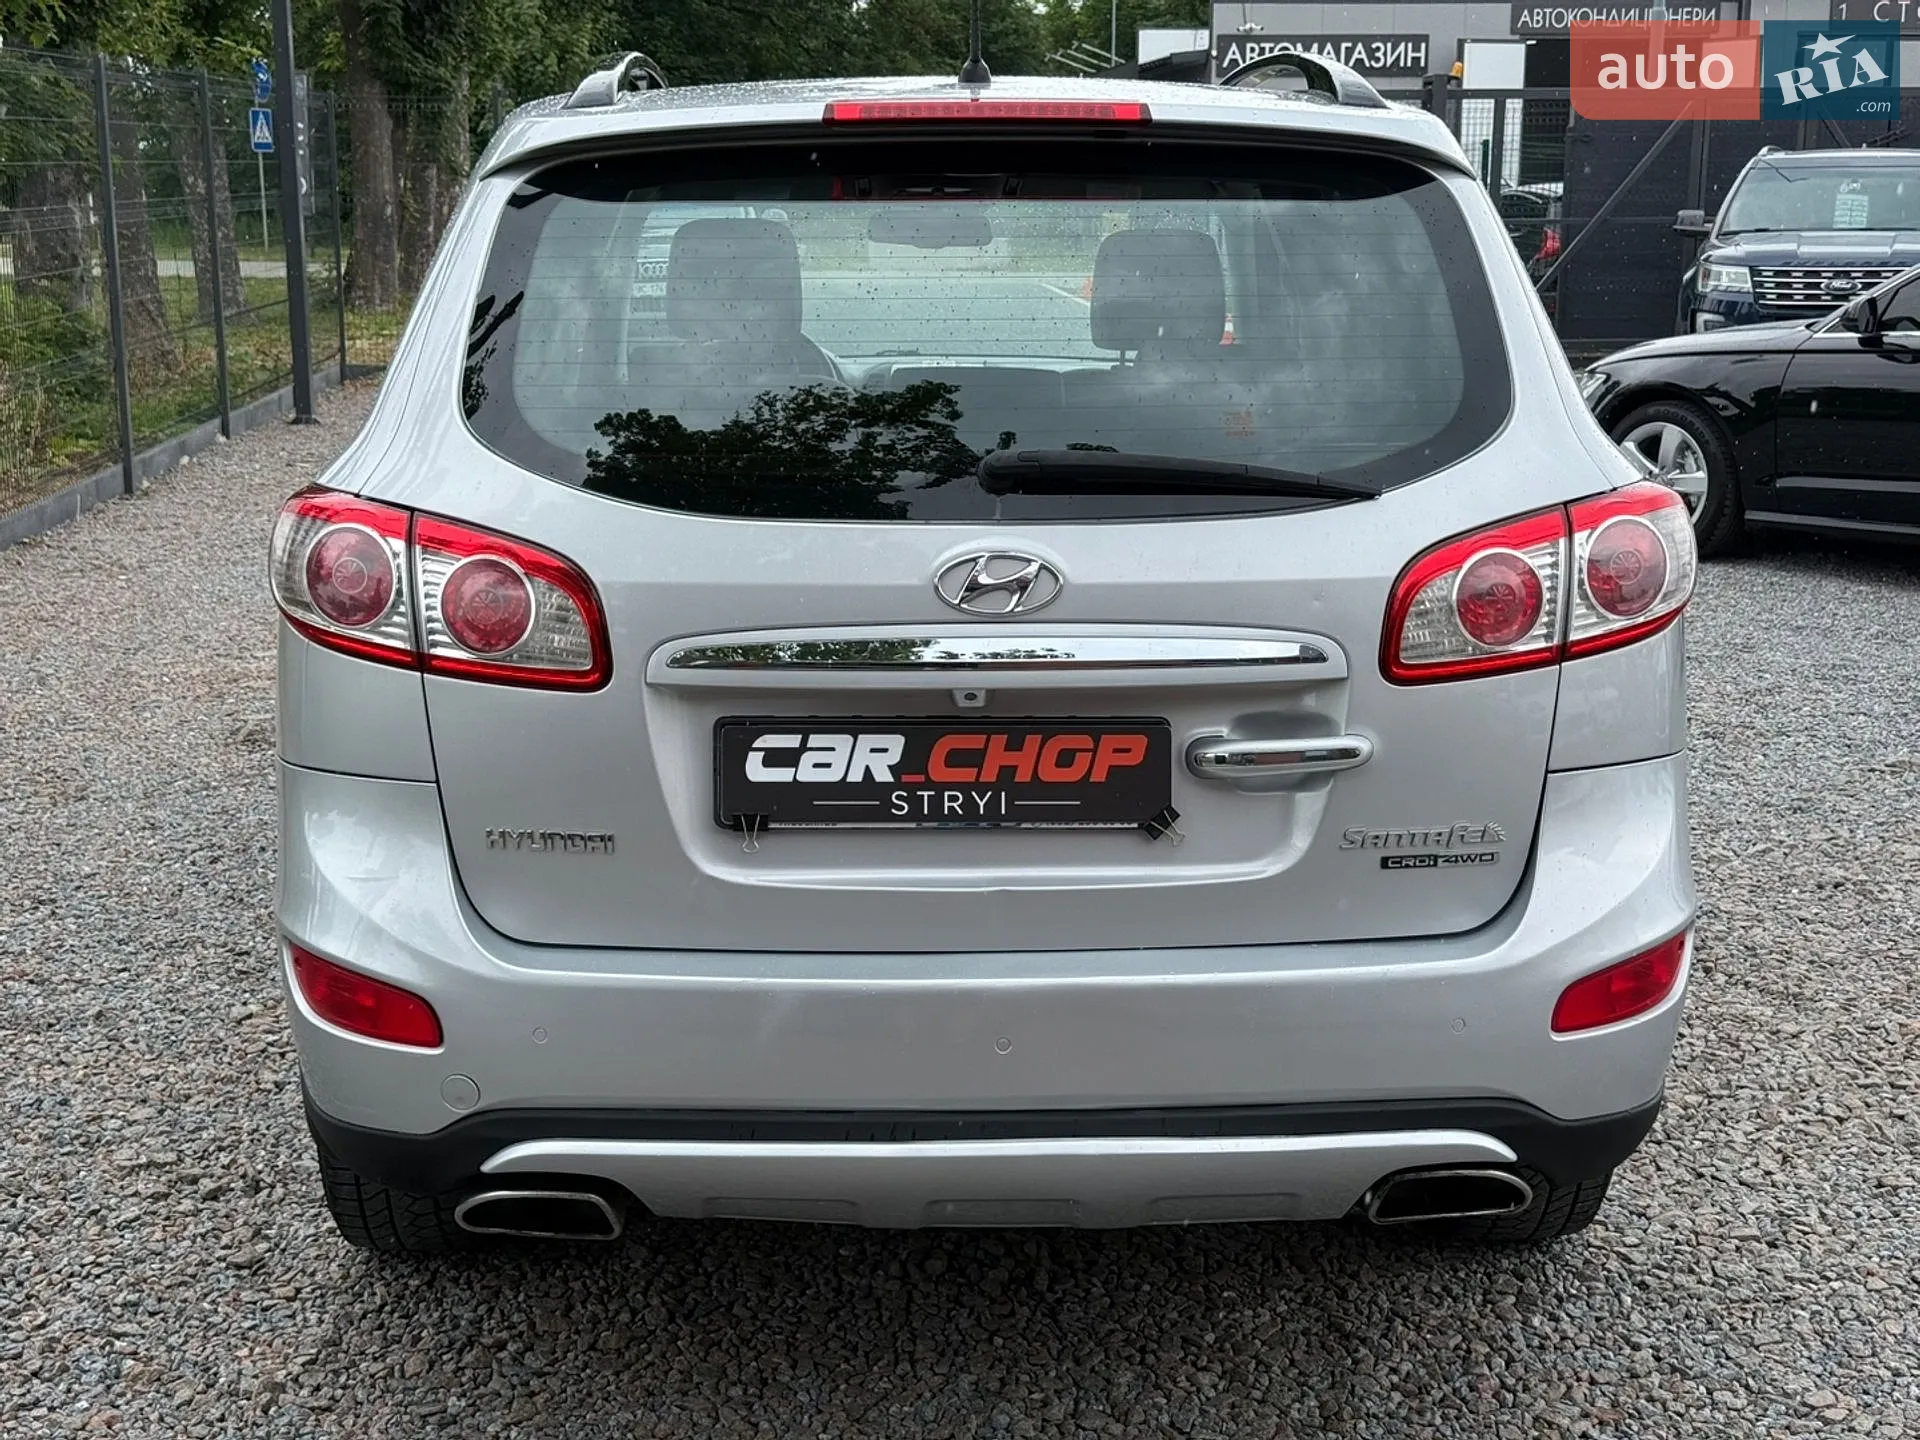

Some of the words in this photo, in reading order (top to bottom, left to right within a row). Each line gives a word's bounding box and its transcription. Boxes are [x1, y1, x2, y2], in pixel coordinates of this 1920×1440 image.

[1517, 7, 1716, 31] АВТОКОНДИЦІНЕРИ
[1873, 1, 1920, 23] СТ
[890, 790, 1007, 816] STRYI
[485, 827, 616, 854] HYUNDAI
